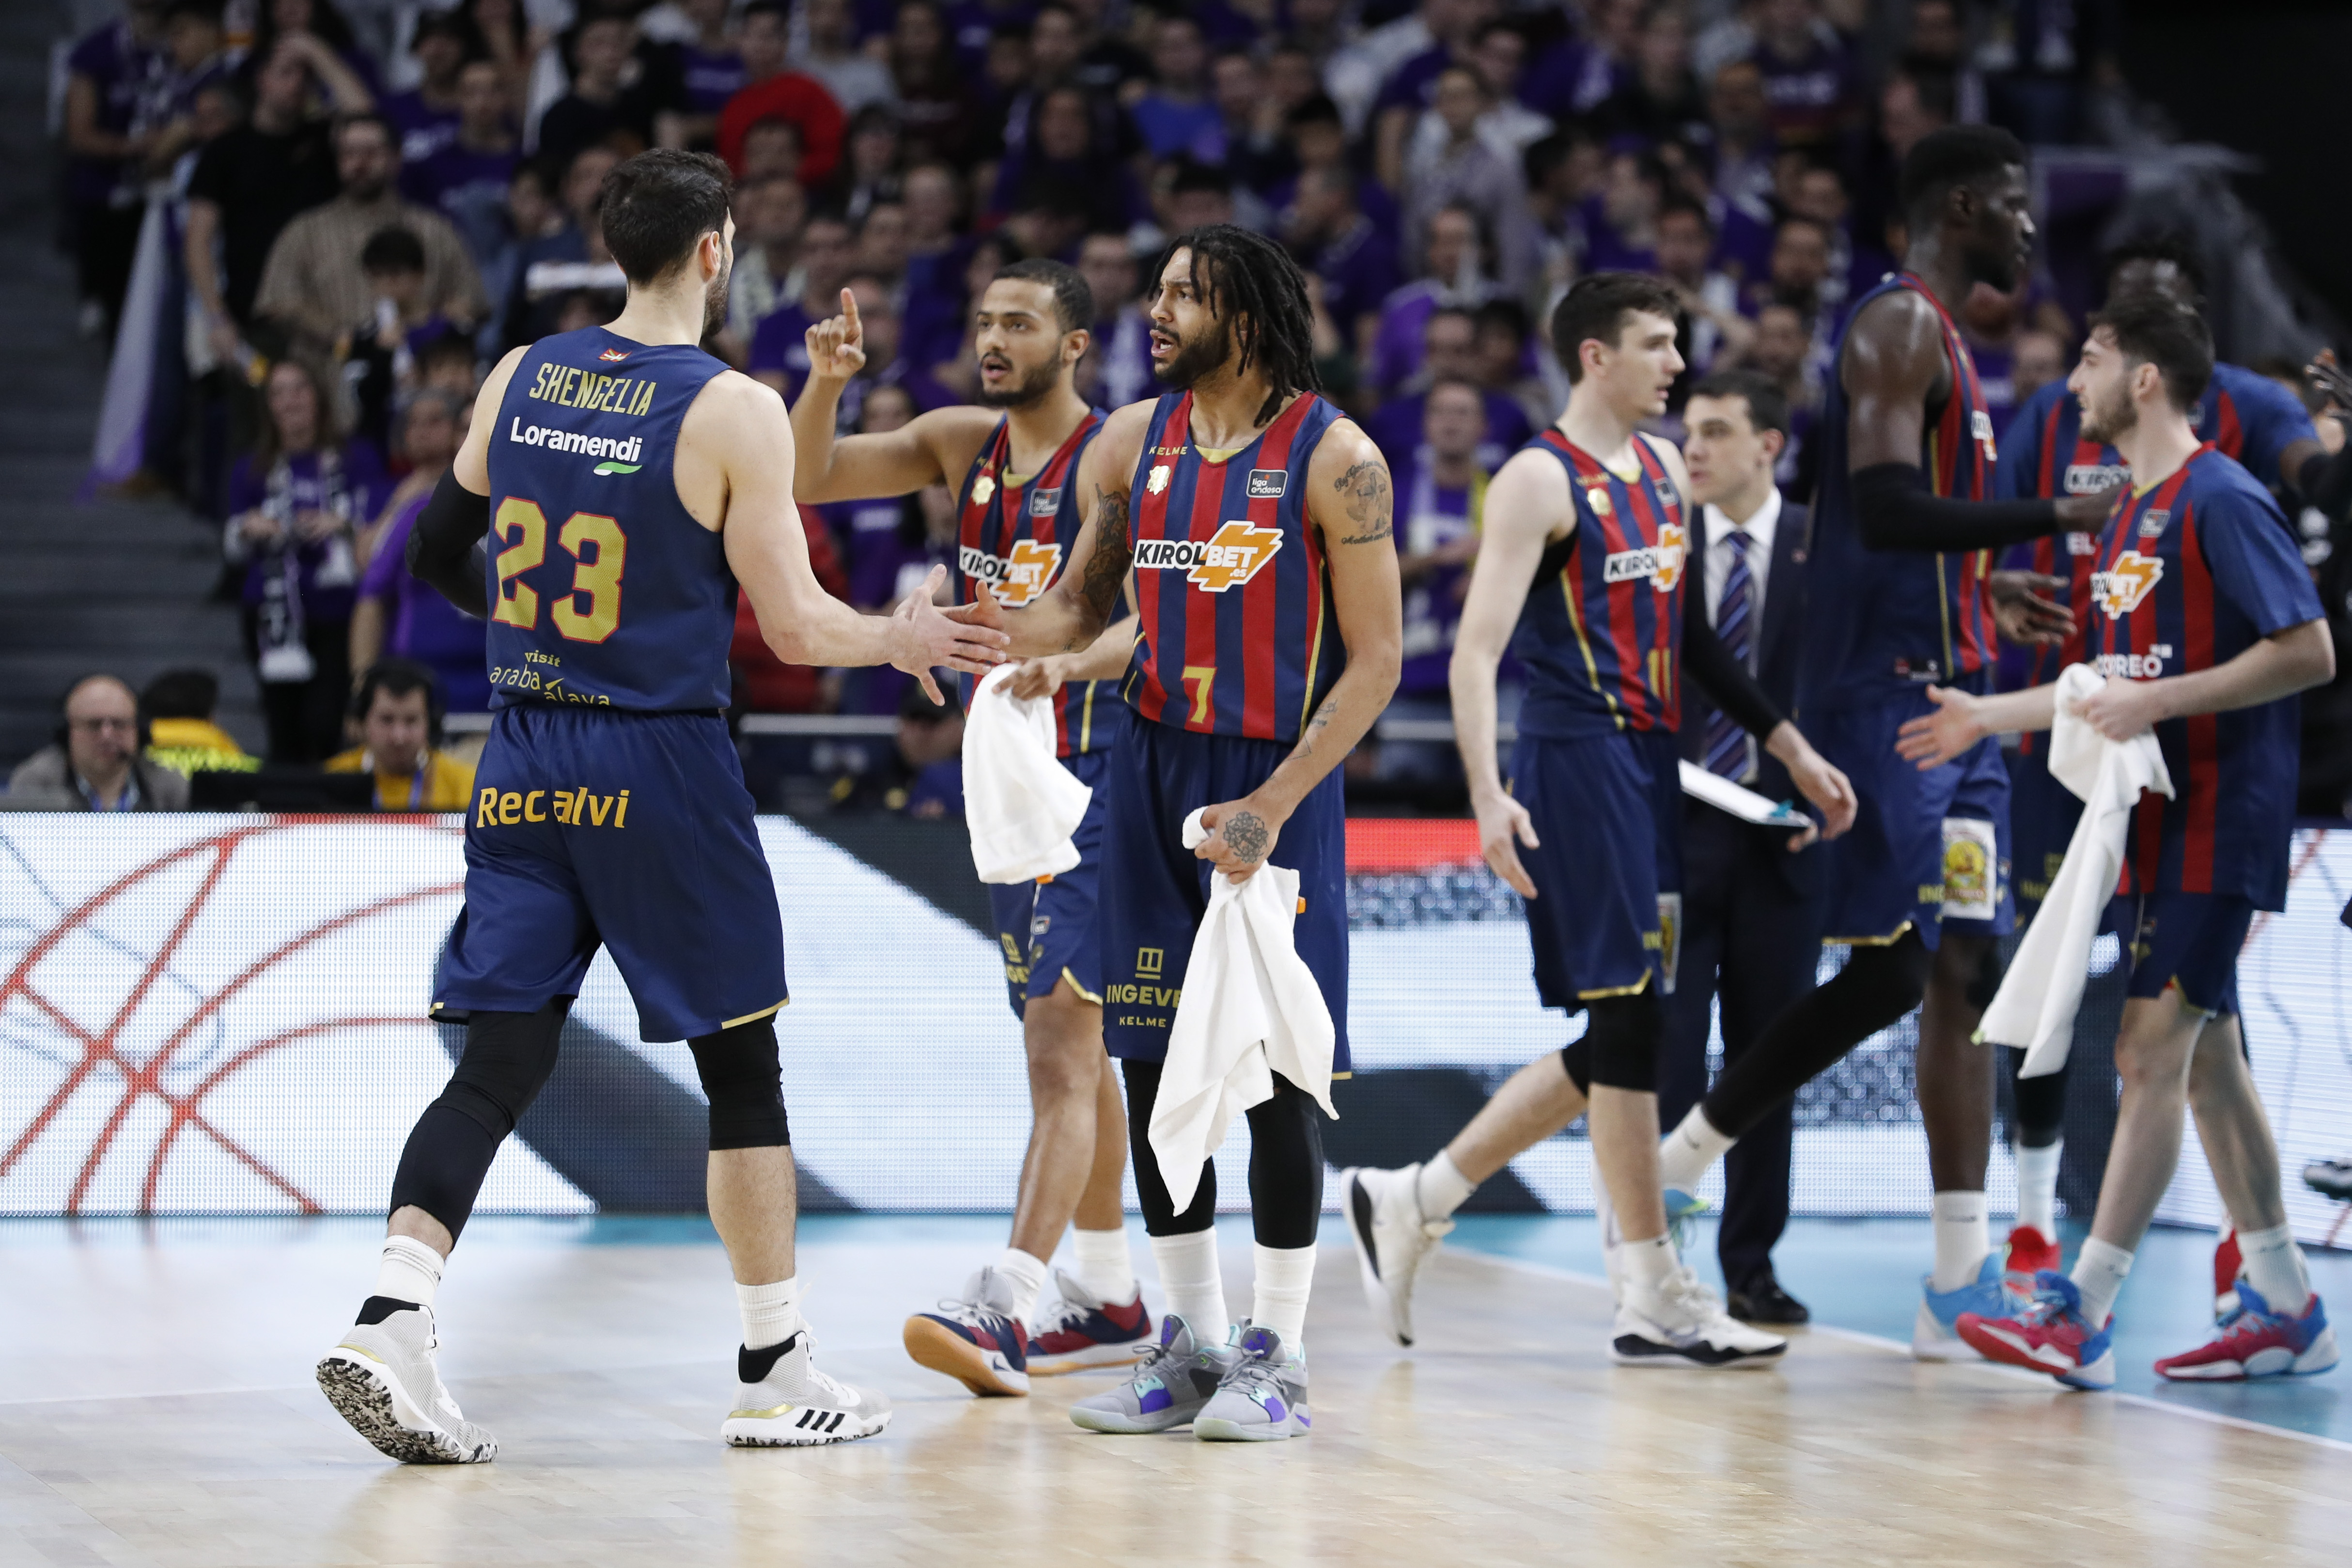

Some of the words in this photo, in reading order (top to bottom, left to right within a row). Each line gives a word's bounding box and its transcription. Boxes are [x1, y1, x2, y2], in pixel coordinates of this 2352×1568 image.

[529, 362, 656, 416] SHENGELIA
[510, 417, 642, 462] Loramendi
[1149, 446, 1188, 456] KELME
[1251, 486, 1282, 494] endesa
[1252, 478, 1267, 487] liga
[1137, 544, 1258, 568] KIROLBET
[492, 496, 627, 644] 23
[524, 650, 561, 667] visit
[489, 664, 540, 690] araba
[1182, 666, 1216, 724] 7
[476, 786, 630, 828] Recalvi
[1119, 1016, 1167, 1028] KELME
